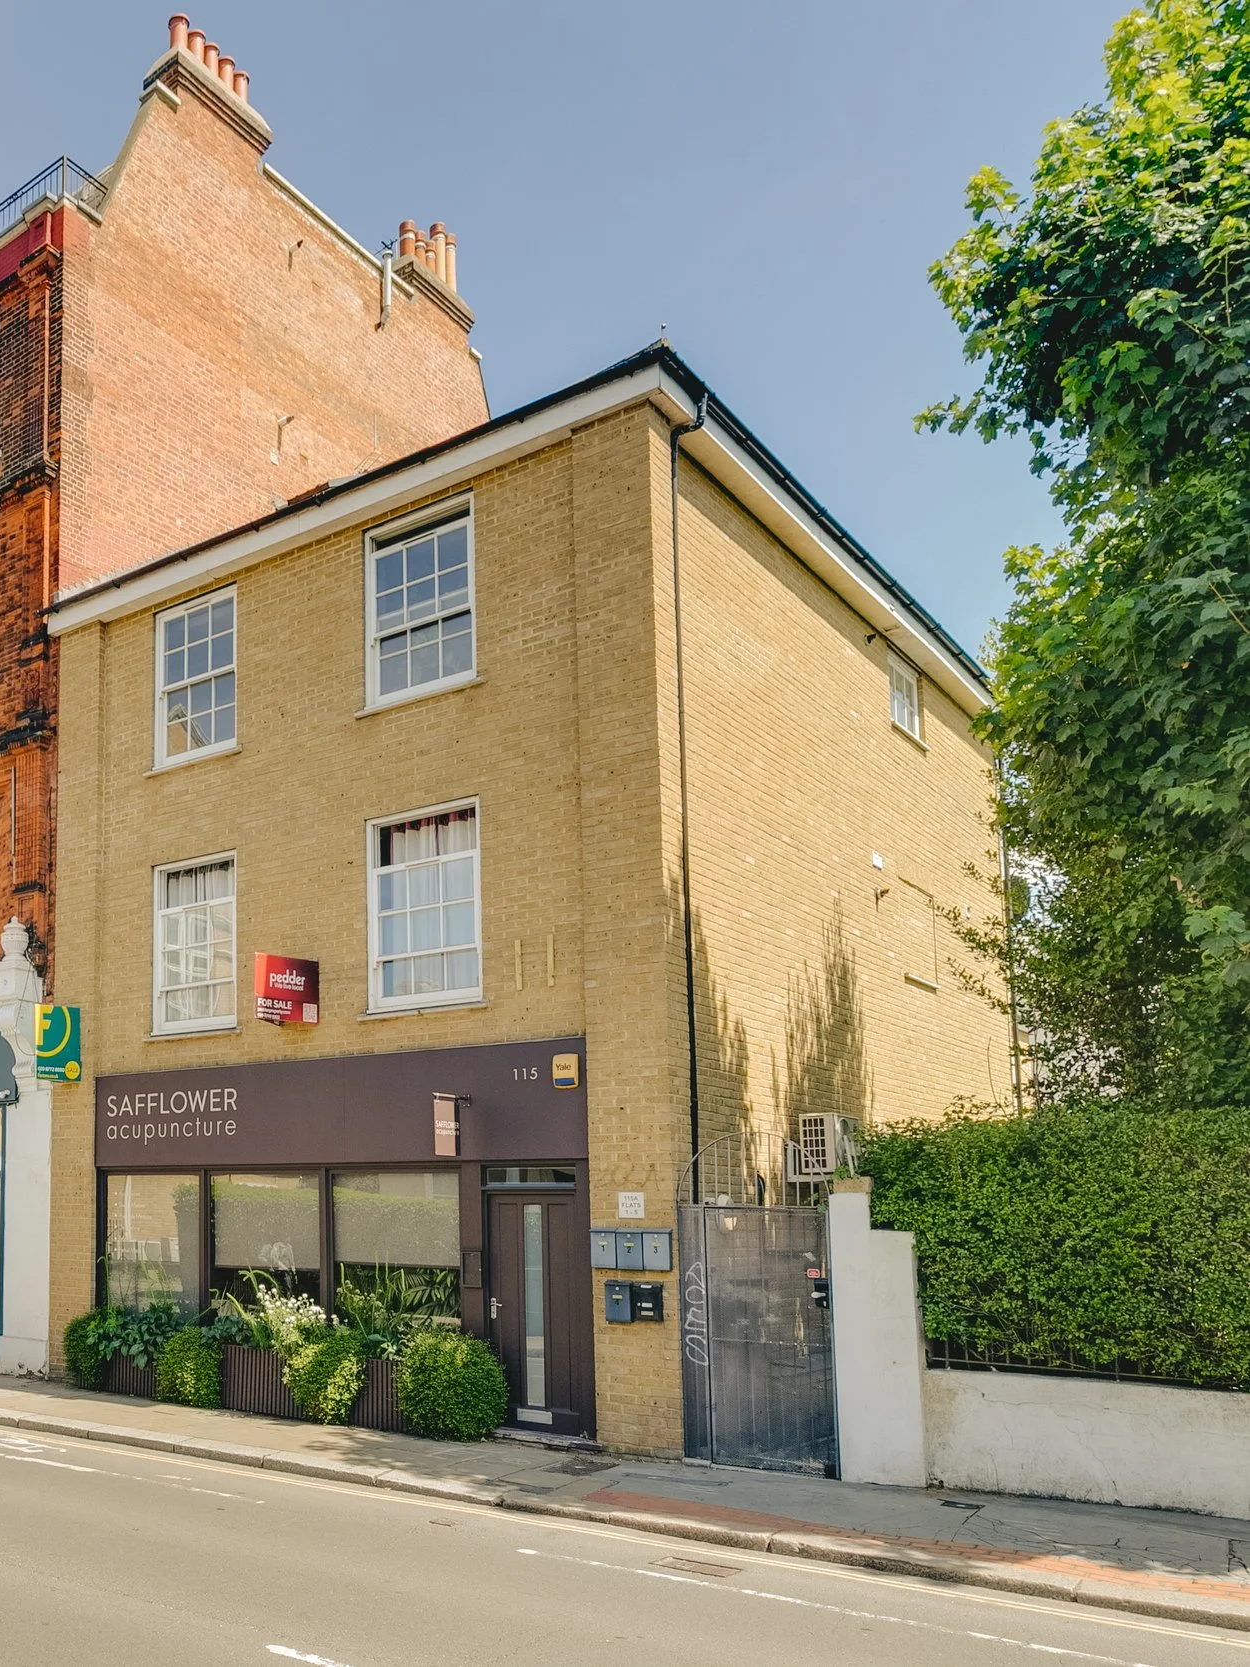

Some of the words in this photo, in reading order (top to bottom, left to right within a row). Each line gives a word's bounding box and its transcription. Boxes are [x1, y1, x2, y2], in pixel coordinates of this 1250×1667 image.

[269, 969, 306, 988] pedder
[257, 997, 273, 1008] FOR
[273, 999, 293, 1010] SALE
[555, 1062, 572, 1071] Yale
[512, 1067, 539, 1081] 115
[107, 1087, 238, 1118] SAFFLOWER
[106, 1116, 237, 1146] acupuncture
[435, 1119, 460, 1130] SAFFLOWER
[626, 1246, 632, 1254] 2
[653, 1246, 659, 1254] 3
